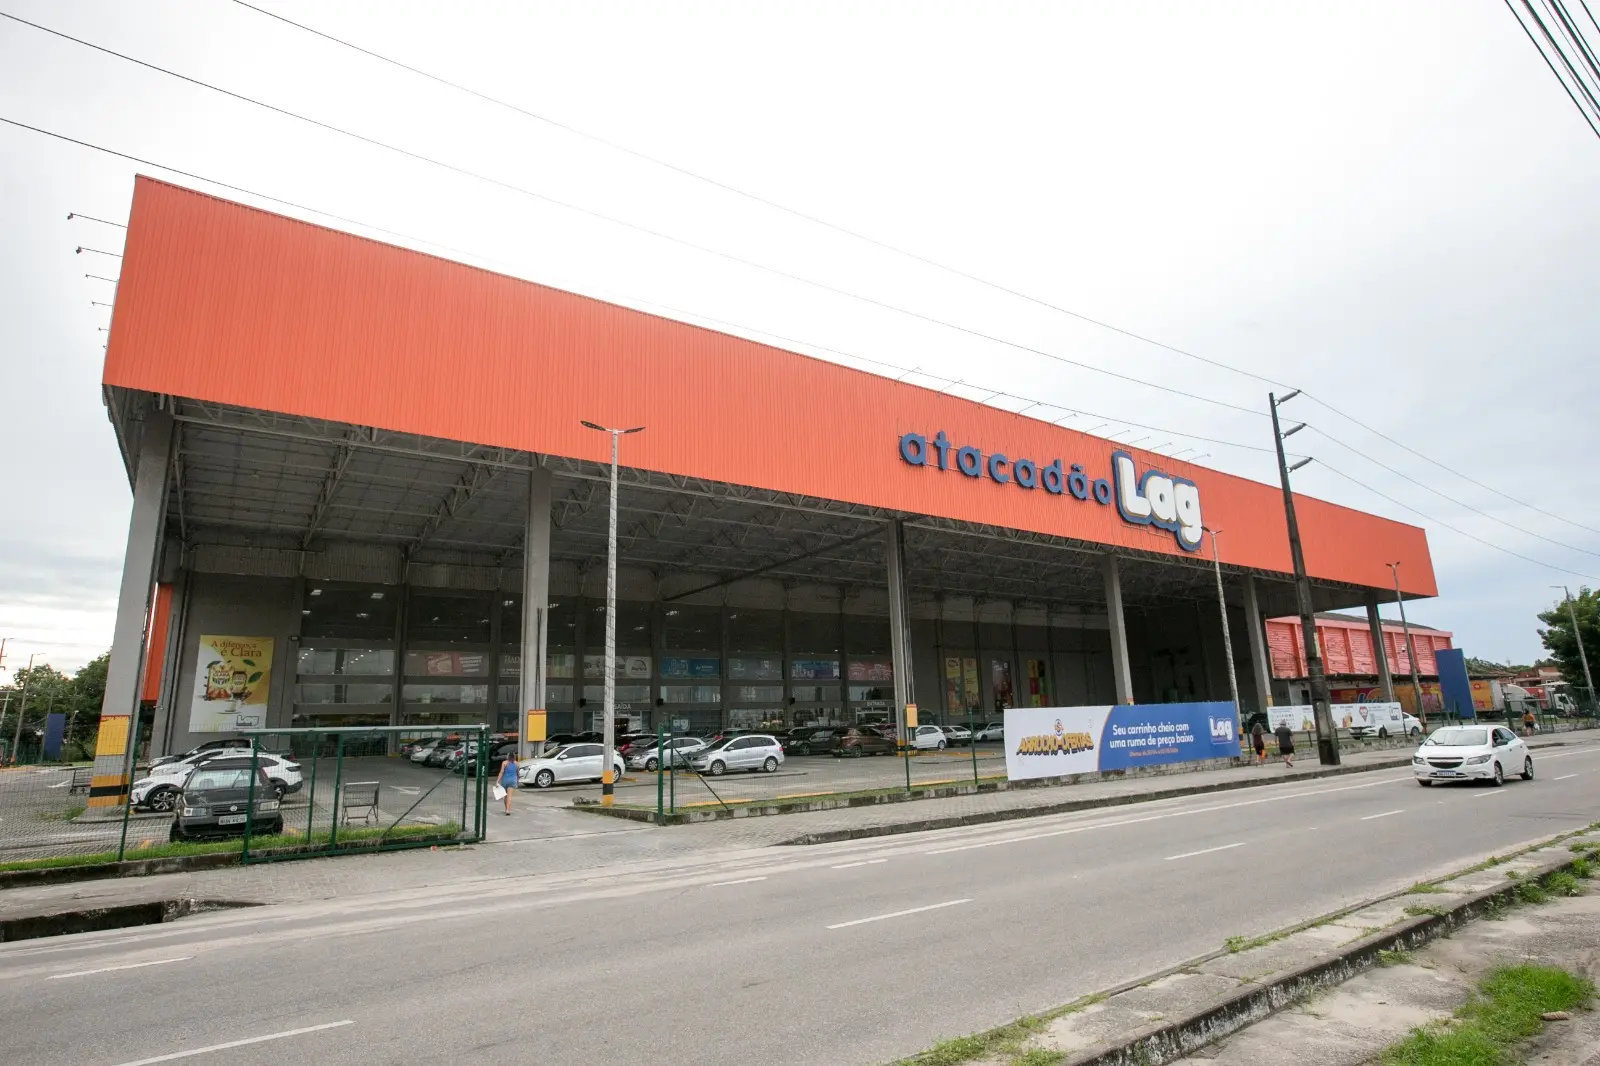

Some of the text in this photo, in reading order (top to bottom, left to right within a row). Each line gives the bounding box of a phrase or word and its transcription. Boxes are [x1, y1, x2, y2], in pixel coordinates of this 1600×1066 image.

[899, 431, 1203, 550] atacadão Lag
[231, 648, 262, 657] Clara
[1112, 721, 1189, 735] Seu carrinho cheio com
[1209, 717, 1233, 741] Lag
[1109, 732, 1194, 749] uma ruma de preço baixo
